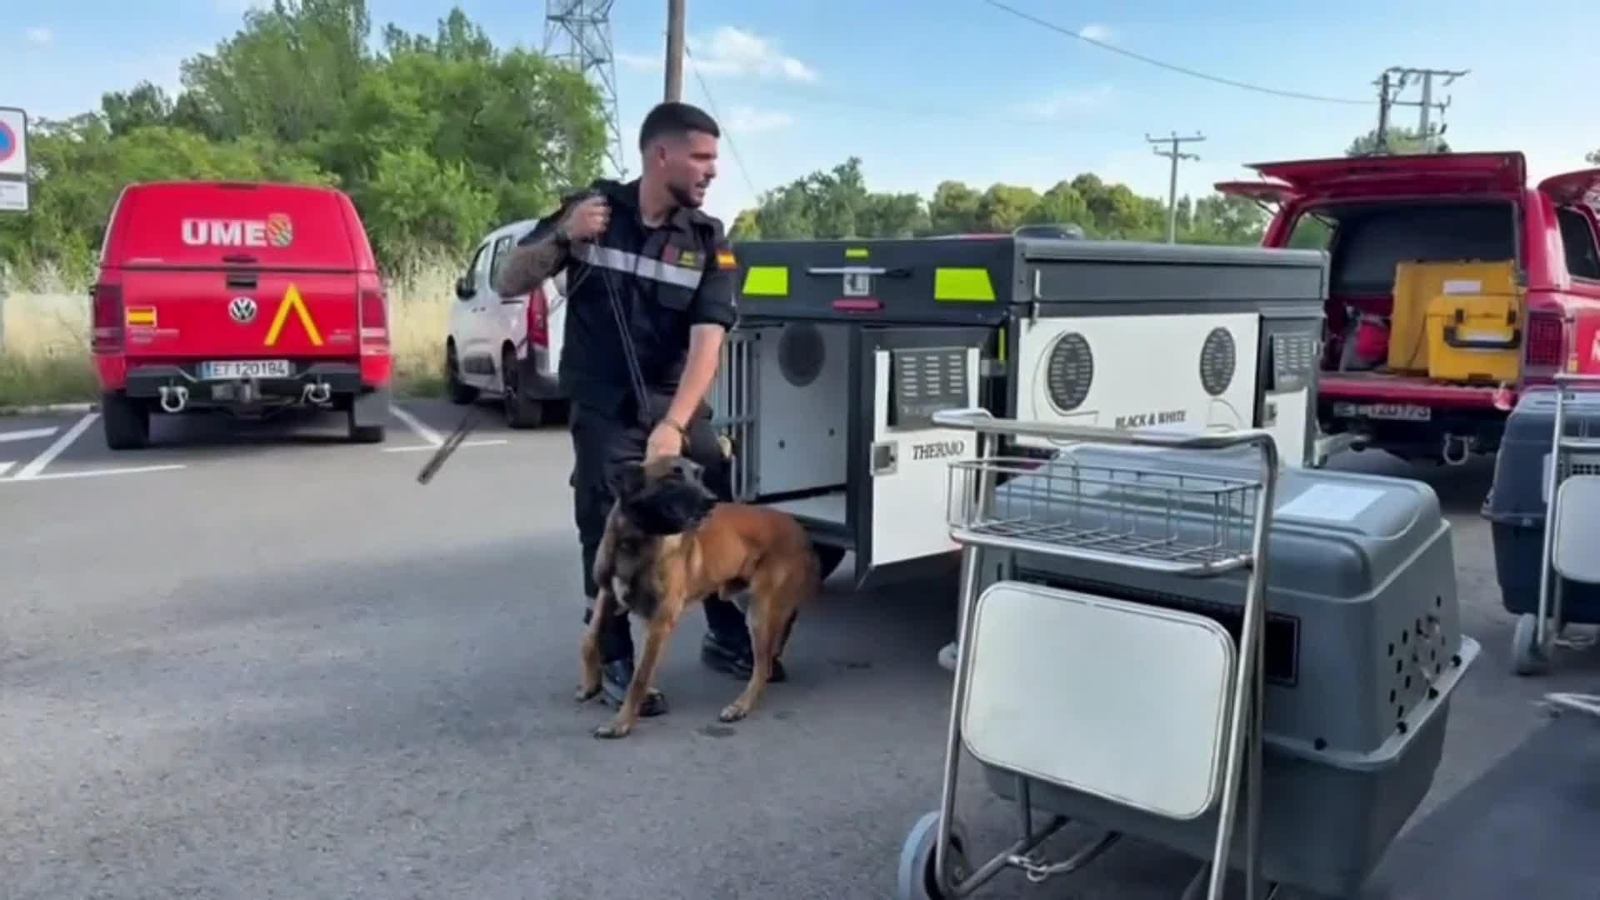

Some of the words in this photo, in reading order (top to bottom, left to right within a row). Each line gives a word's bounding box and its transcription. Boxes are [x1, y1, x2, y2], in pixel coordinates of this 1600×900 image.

[181, 218, 267, 247] UME
[1115, 414, 1147, 430] BLACK
[1148, 412, 1156, 426] &
[1158, 409, 1187, 424] WHITE
[912, 440, 965, 460] THERMO
